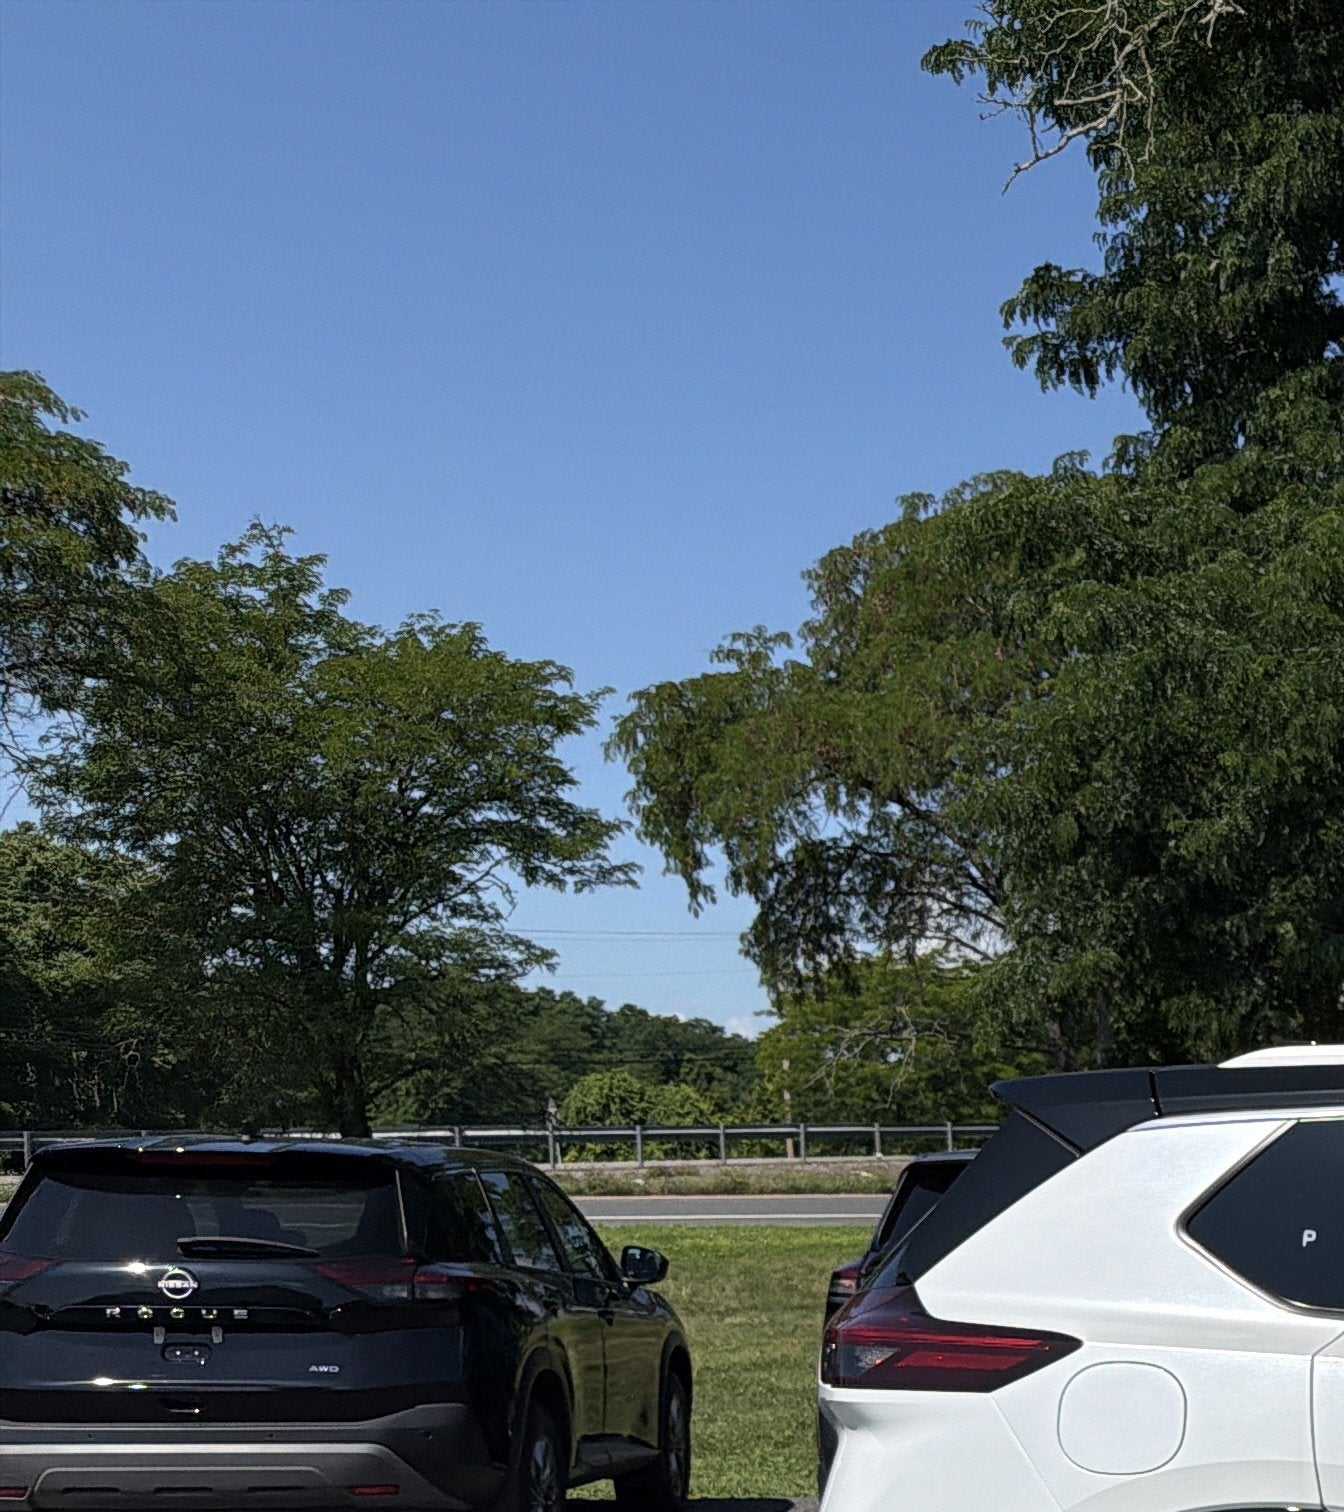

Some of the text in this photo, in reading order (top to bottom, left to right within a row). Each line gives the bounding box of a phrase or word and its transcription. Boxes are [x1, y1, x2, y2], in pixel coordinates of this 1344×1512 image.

[1302, 1229, 1317, 1247] P
[157, 1280, 198, 1288] NISSAN
[106, 1307, 249, 1319] ROGUE
[308, 1364, 340, 1373] AWD
